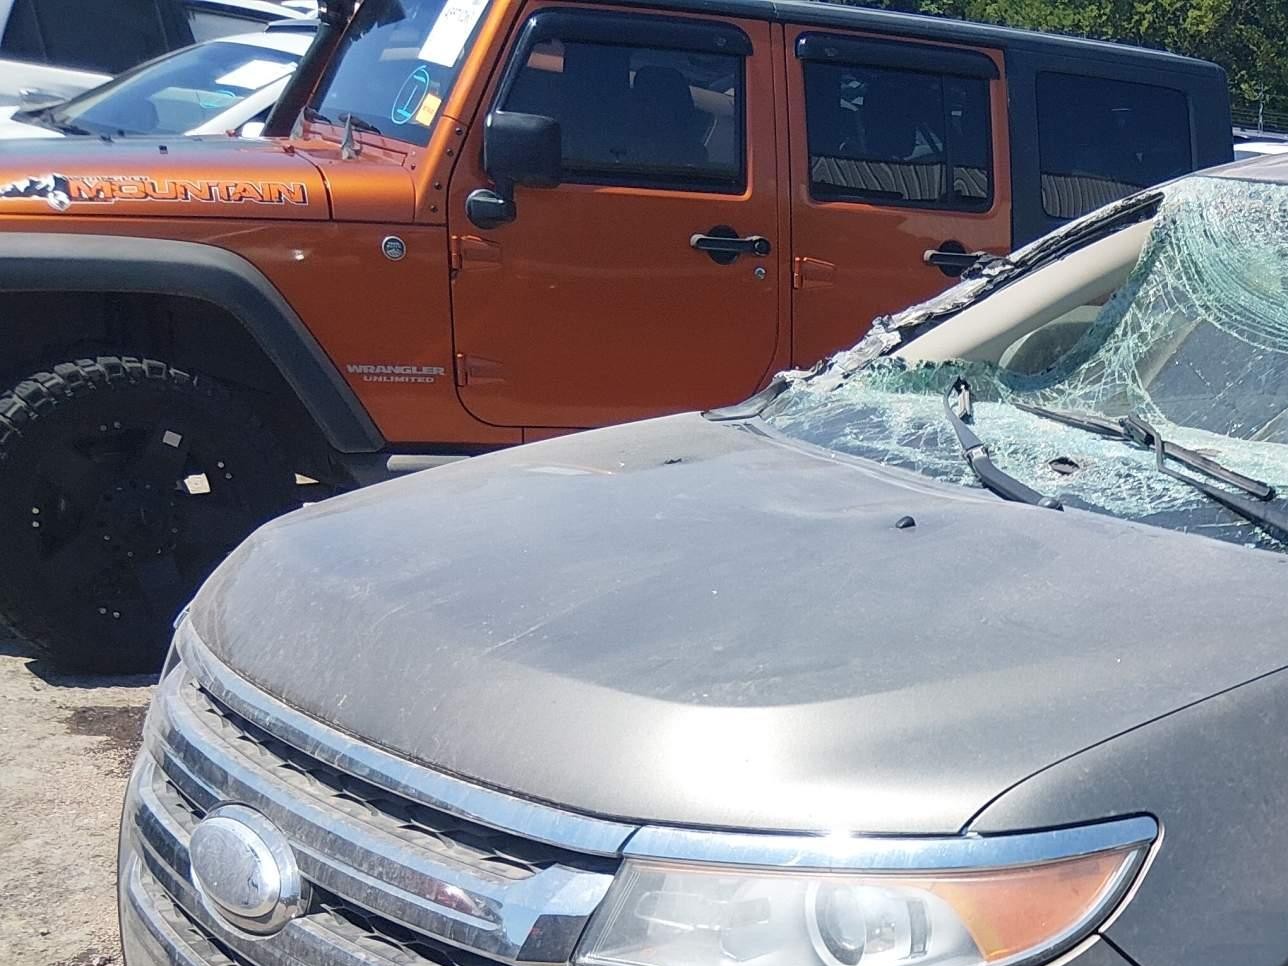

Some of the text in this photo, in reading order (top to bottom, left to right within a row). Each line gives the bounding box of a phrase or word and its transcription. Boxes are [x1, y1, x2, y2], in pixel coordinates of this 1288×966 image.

[67, 179, 308, 205] MOUNTAIN
[347, 364, 445, 376] WRANGLER
[363, 375, 435, 384] UNLIMITED
